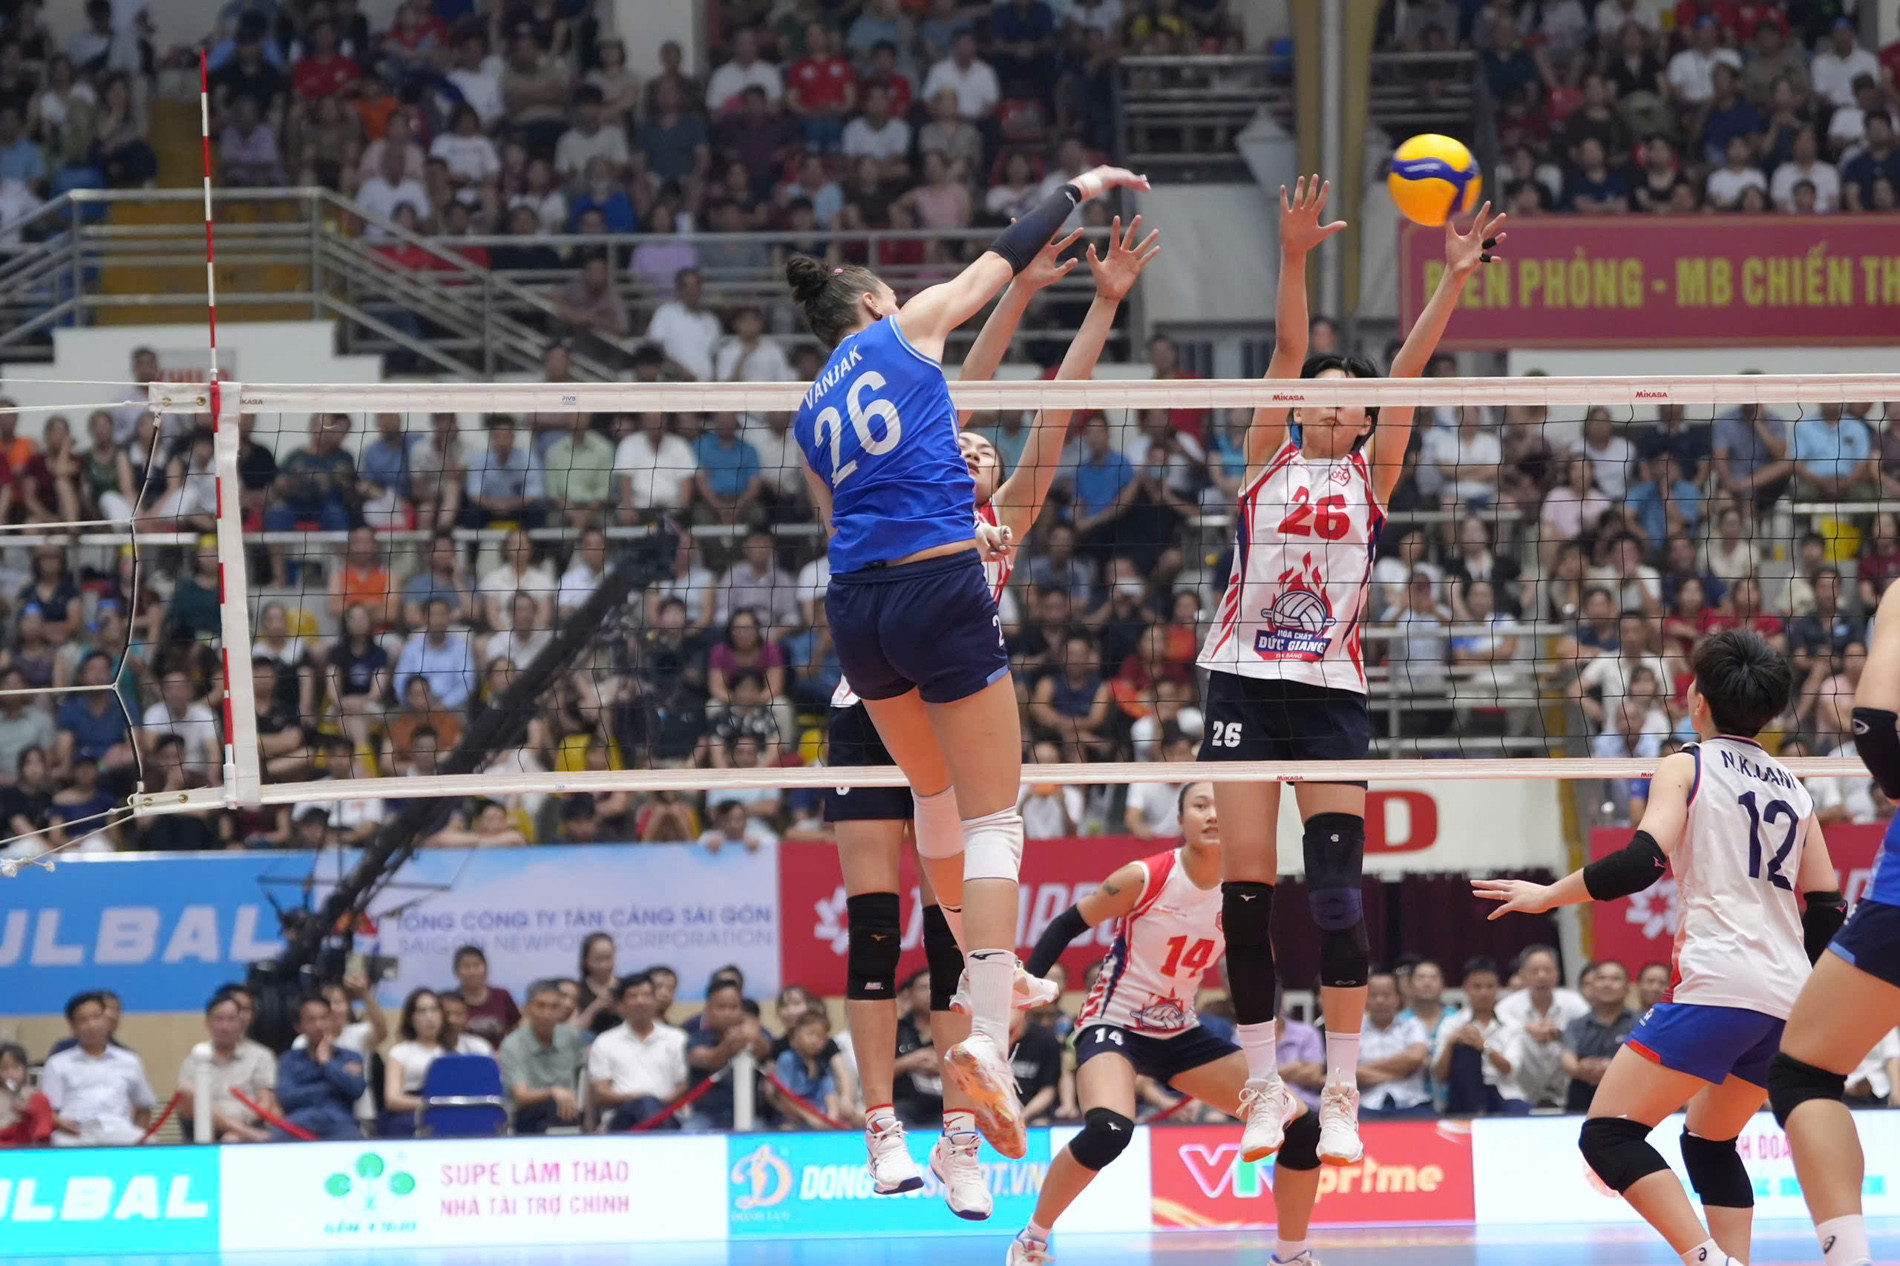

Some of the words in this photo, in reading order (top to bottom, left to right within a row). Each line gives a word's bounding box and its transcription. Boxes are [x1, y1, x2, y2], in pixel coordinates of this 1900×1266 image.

[1518, 247, 1644, 309] PHÒNG
[1676, 257, 1732, 308] MB
[1741, 240, 1853, 306] CHIẾN
[803, 345, 863, 410] VANJAK
[813, 370, 902, 488] 26
[1278, 486, 1350, 540] 26
[1287, 640, 1326, 654] GIANG
[1212, 721, 1243, 748] 26
[1738, 790, 1800, 891] 12
[461, 905, 528, 931] CÔNG
[1161, 935, 1215, 978] 14
[1095, 1028, 1124, 1046] 14
[440, 1161, 501, 1187] SUPE
[572, 1160, 630, 1183] THAO
